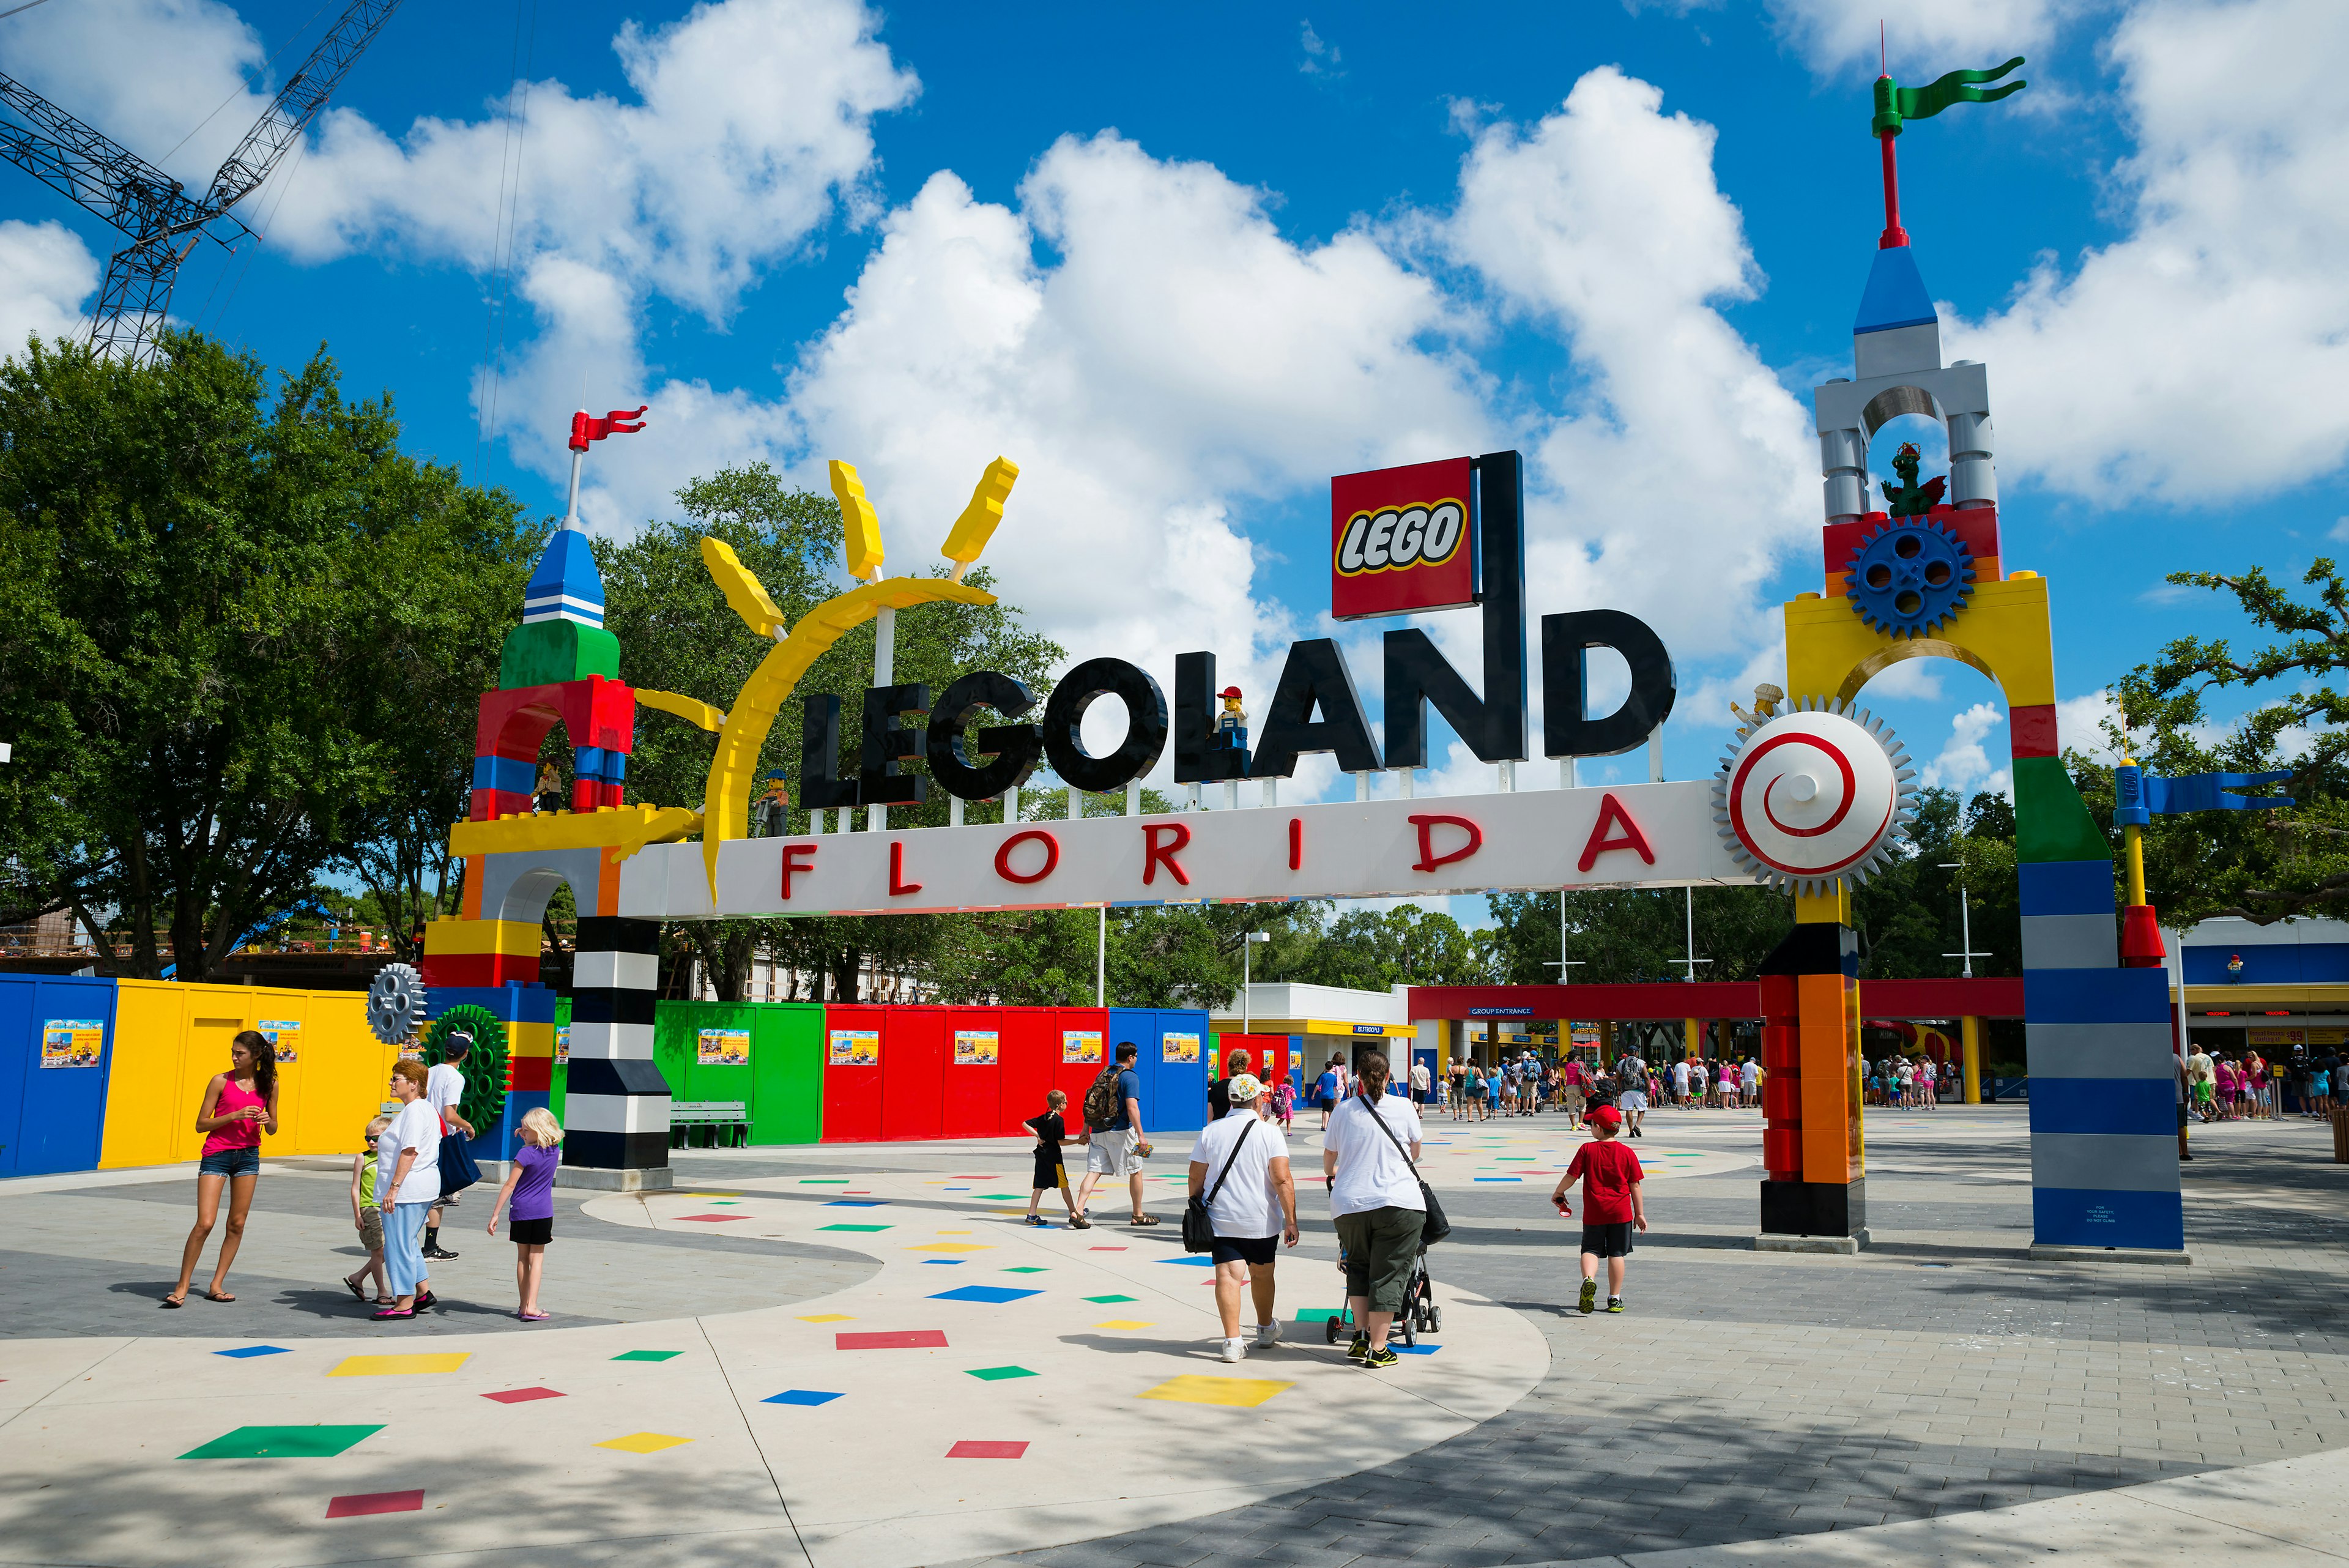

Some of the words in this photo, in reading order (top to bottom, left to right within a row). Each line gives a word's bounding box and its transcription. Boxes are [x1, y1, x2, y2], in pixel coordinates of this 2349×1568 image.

[1341, 504, 1460, 569] LEGO
[800, 449, 1677, 810] LEGOLAND
[781, 793, 1655, 900] FLORIDA
[2285, 1030, 2303, 1042] $99
